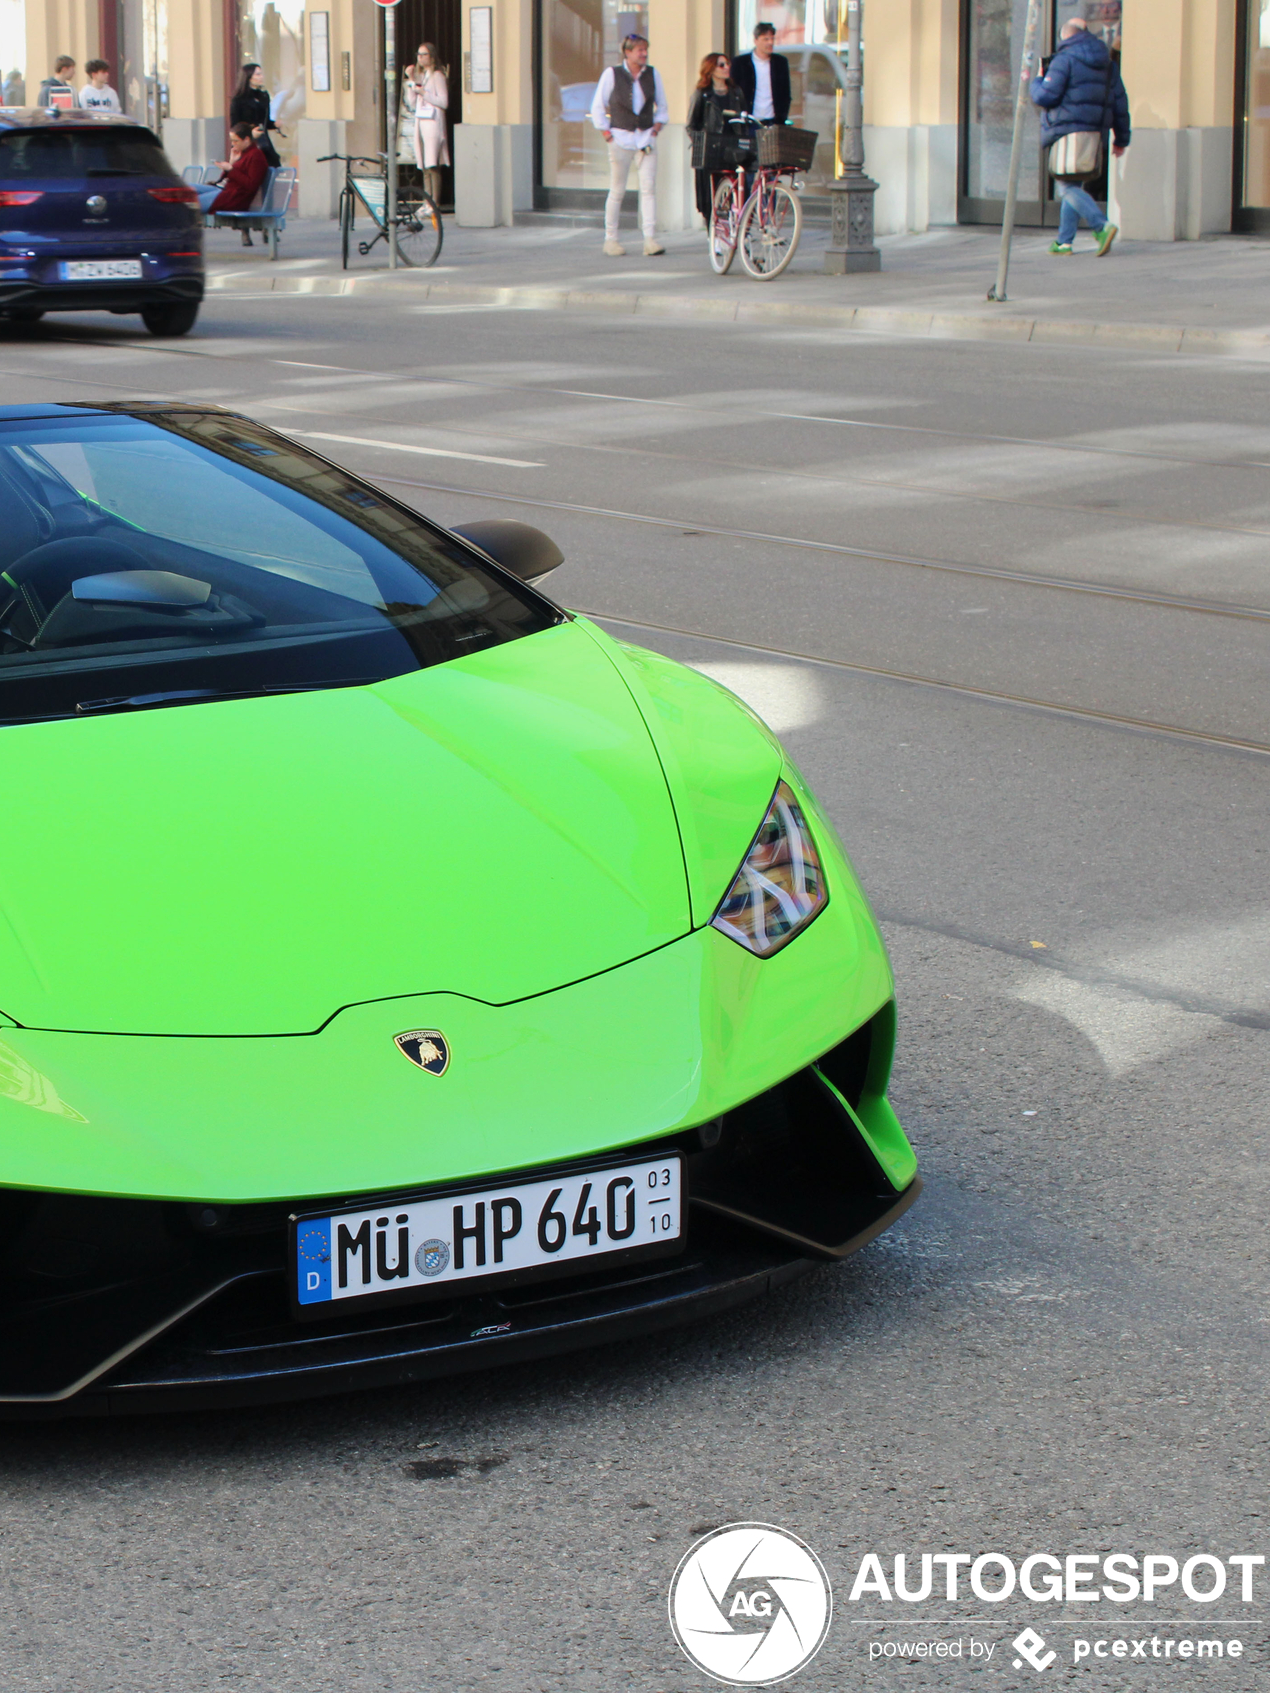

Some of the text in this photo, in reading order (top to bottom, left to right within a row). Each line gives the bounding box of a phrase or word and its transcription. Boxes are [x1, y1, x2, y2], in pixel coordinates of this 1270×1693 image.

[398, 1031, 441, 1044] LAMBORGHINI
[647, 1168, 671, 1189] 03
[453, 1196, 523, 1270] HP
[537, 1176, 636, 1254] 640
[649, 1212, 671, 1234] 10
[306, 1271, 320, 1291] D
